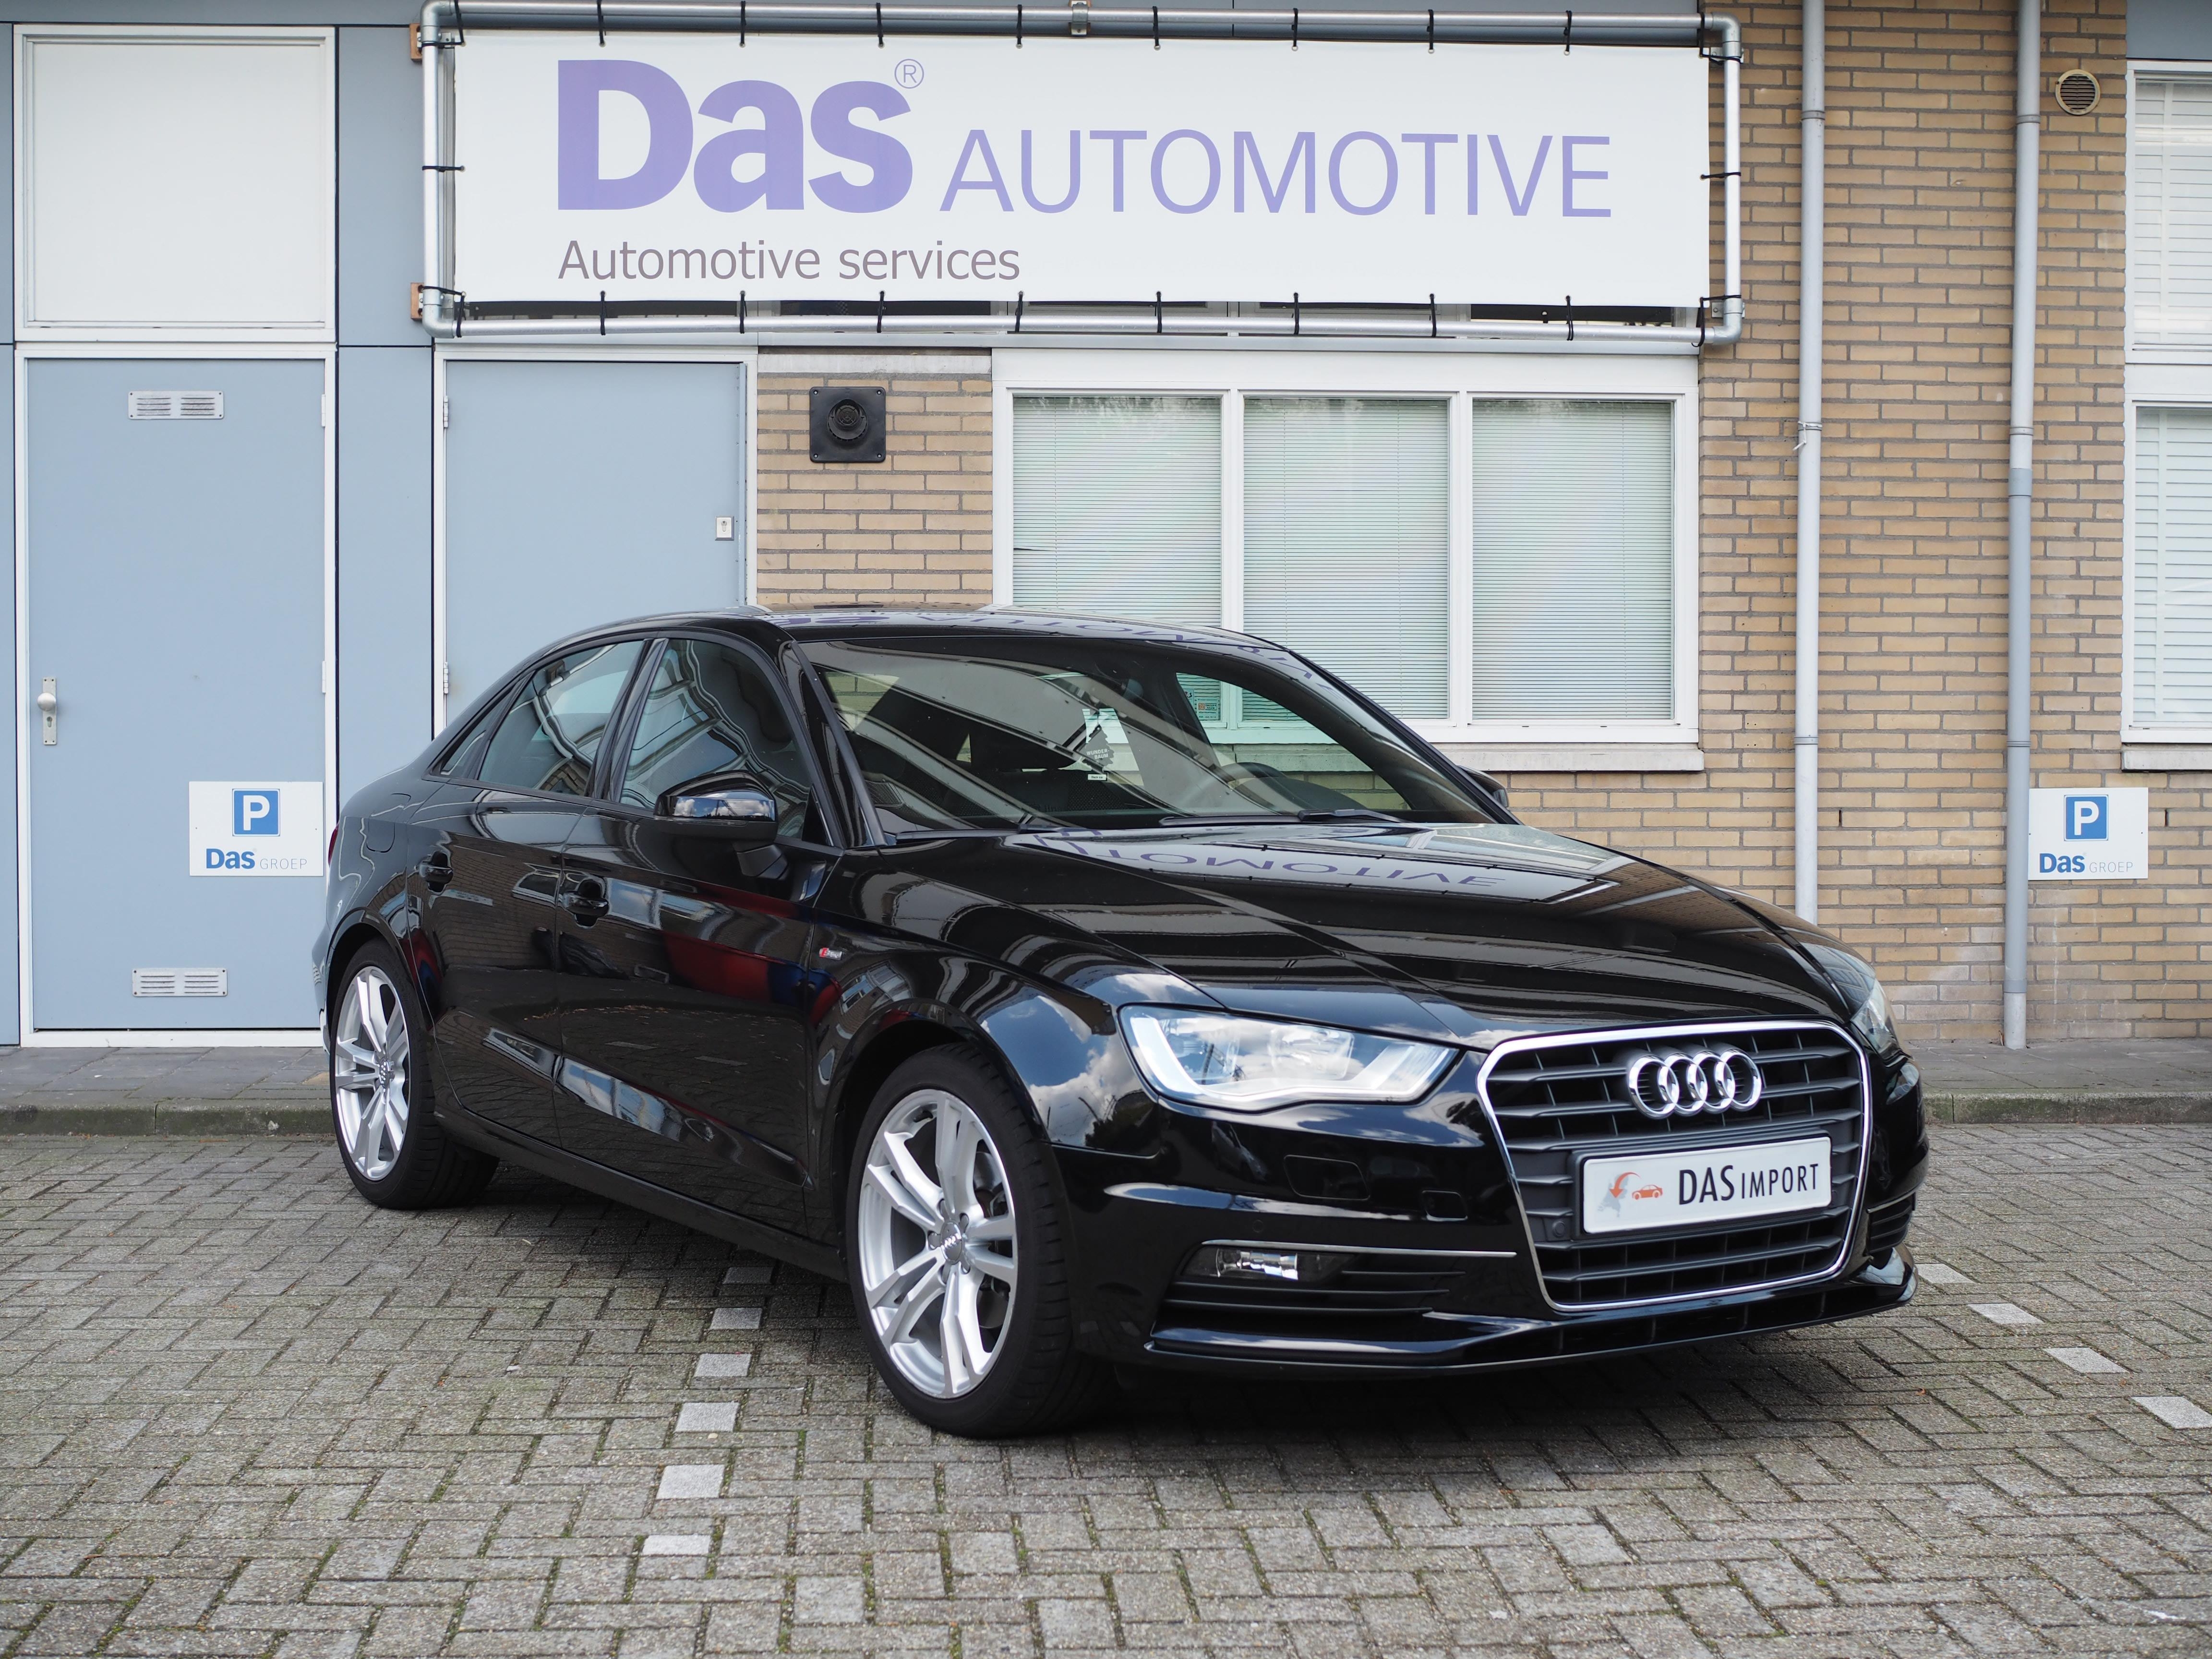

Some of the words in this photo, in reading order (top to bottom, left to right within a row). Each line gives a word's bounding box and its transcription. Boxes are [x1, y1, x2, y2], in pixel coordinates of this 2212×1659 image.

[558, 60, 913, 213] Das
[940, 129, 1611, 217] AUTOMOTIVE
[558, 240, 820, 280] Automotive
[840, 240, 1020, 280] services
[243, 795, 270, 830] P
[2074, 801, 2099, 835] P
[206, 848, 255, 869] Das
[260, 858, 307, 870] GROEP
[2039, 853, 2085, 873] Das
[2089, 862, 2133, 873] GROEP
[1679, 1165, 1735, 1205] DAS
[1742, 1163, 1818, 1199] IMPORT
